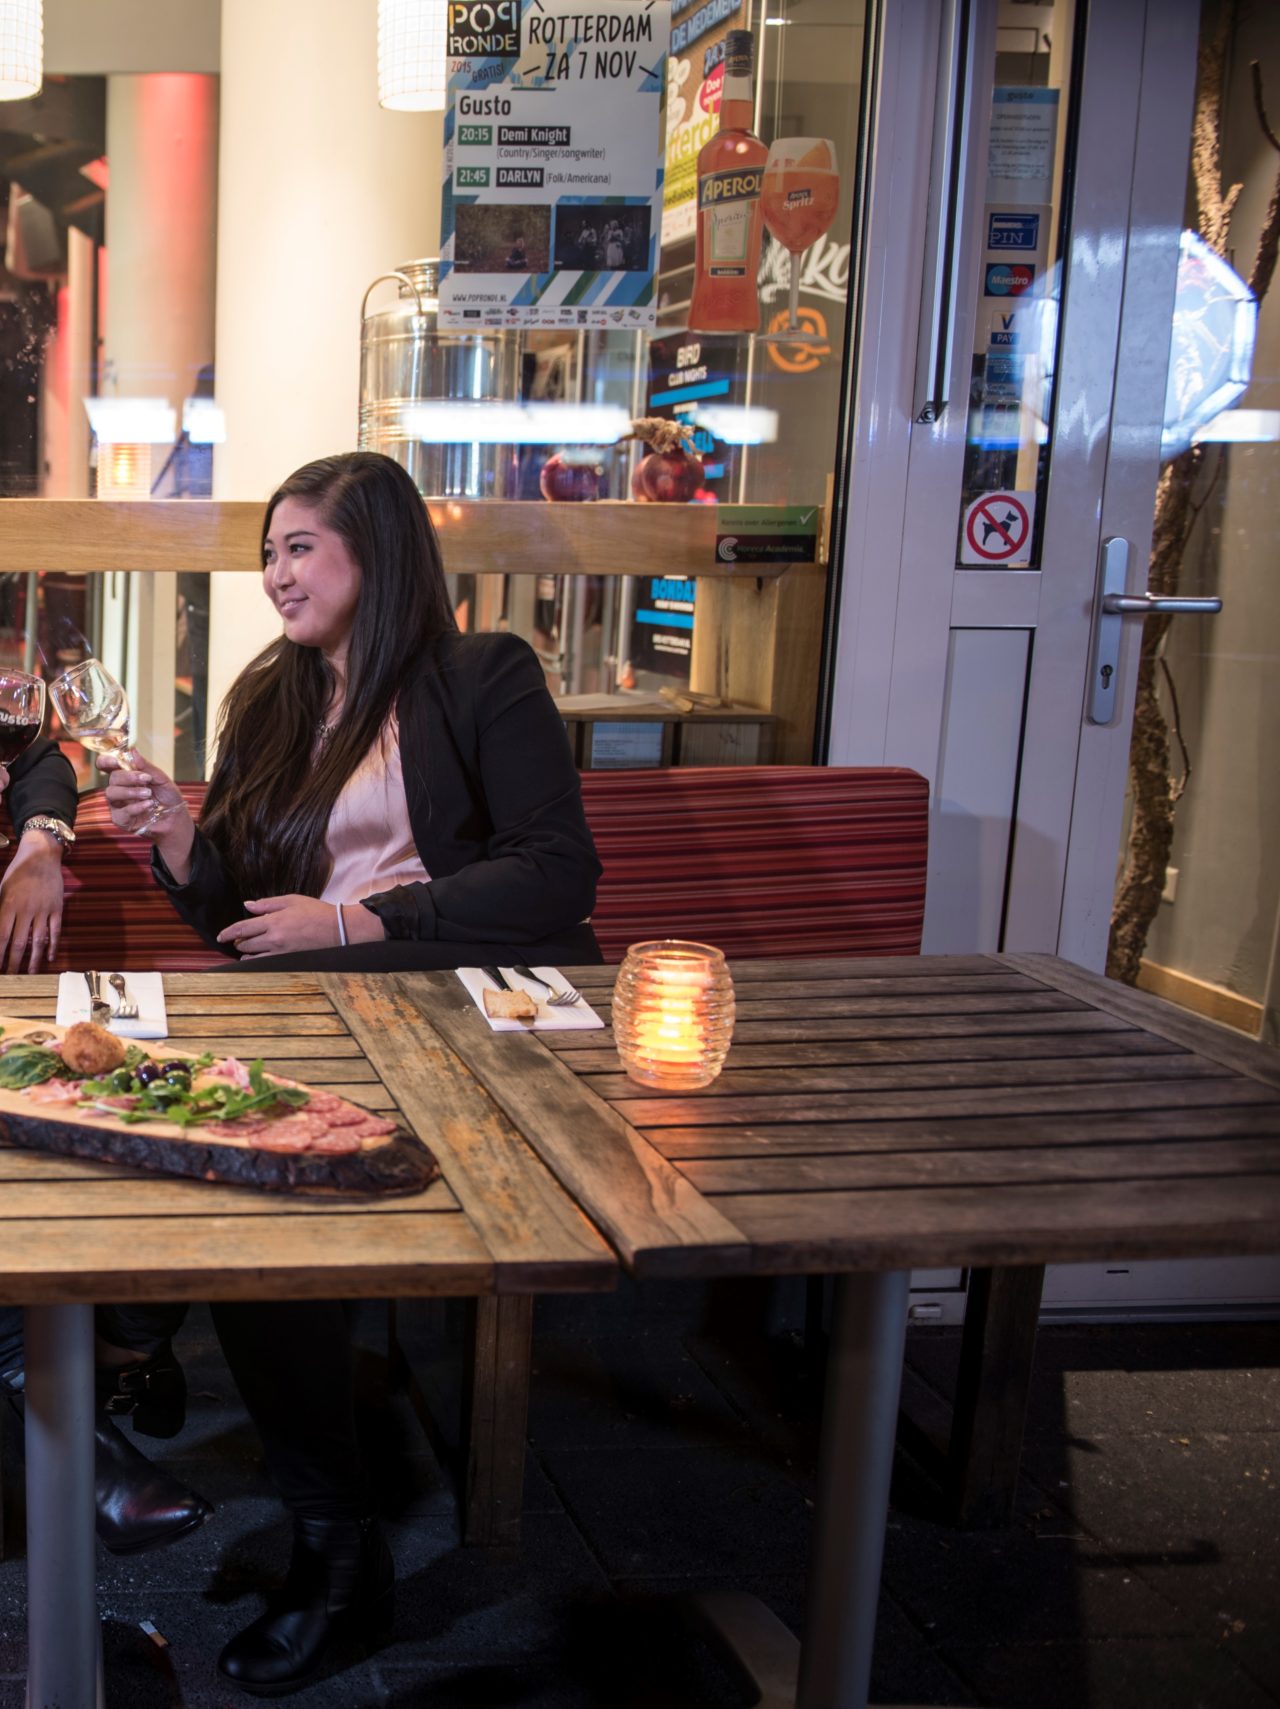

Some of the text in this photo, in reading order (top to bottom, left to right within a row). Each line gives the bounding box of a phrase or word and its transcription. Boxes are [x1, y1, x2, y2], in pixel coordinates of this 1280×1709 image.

[528, 14, 652, 44] ROTTERDAM
[449, 33, 517, 54] RONDE
[545, 51, 636, 80] ZA 7 NOV
[460, 96, 511, 116] Gusto
[461, 128, 568, 144] 20:15 Demi Knight
[459, 170, 486, 183] 21:45
[499, 169, 541, 183] DARLYN
[703, 175, 761, 202] APEROL
[989, 231, 1024, 244] PIN
[991, 275, 1028, 286] Maestro
[1001, 314, 1015, 330] V
[997, 334, 1014, 343] PAY
